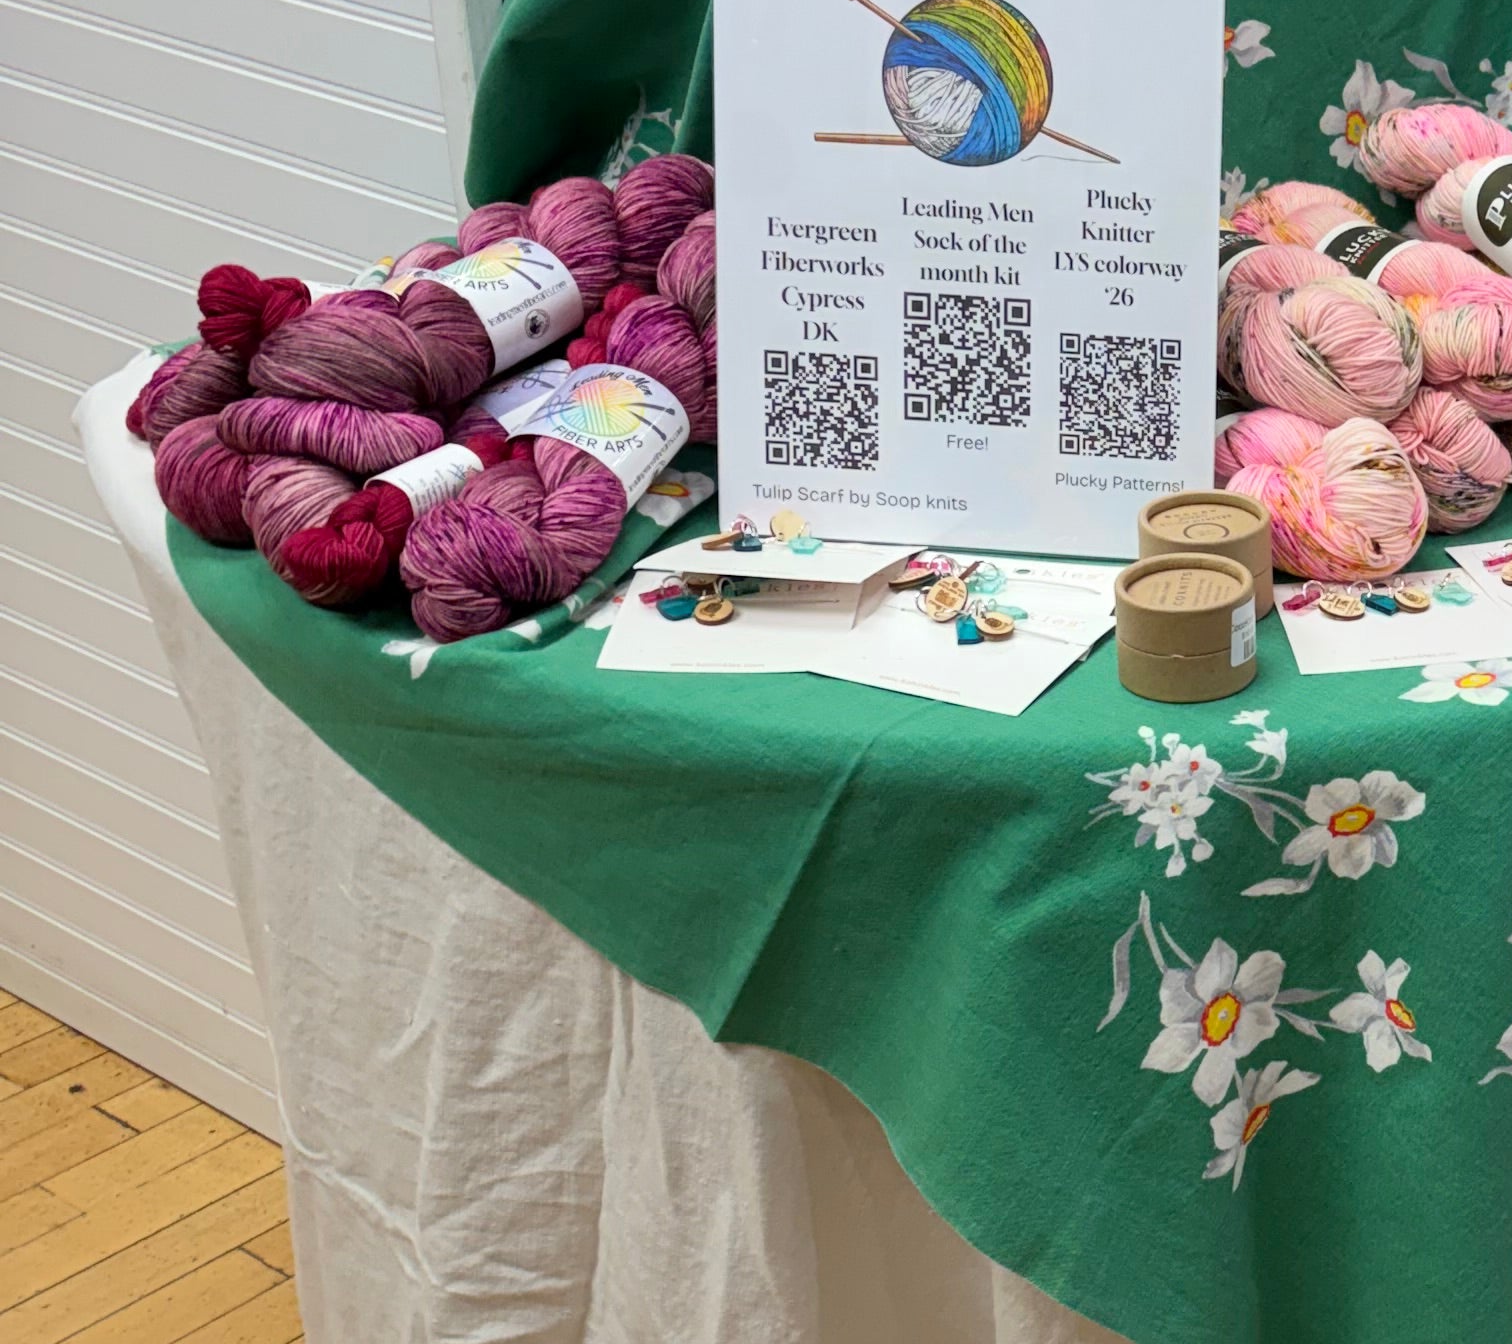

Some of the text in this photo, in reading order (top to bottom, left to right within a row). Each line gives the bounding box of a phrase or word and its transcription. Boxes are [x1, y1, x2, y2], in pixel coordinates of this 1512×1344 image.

[903, 198, 1033, 224] Leading Men
[1088, 190, 1151, 216] Plucky
[768, 217, 876, 243] Evergreen
[915, 231, 1026, 254] Sock of the
[1082, 221, 1154, 243] Knitter
[1339, 228, 1391, 263] LUCKY
[762, 251, 884, 276] Fiberworks
[921, 265, 1020, 285] month kit
[1056, 252, 1187, 282] LYS colorway
[464, 279, 509, 292] ARTS
[782, 287, 864, 312] Cypress
[804, 321, 838, 341] DK
[625, 375, 653, 397] Men
[552, 425, 643, 454] FIBER ARTS
[947, 435, 988, 450] Free!
[1056, 473, 1184, 491] Plucky Patterns!
[753, 484, 967, 510] Tulip Scarf by Soop knits
